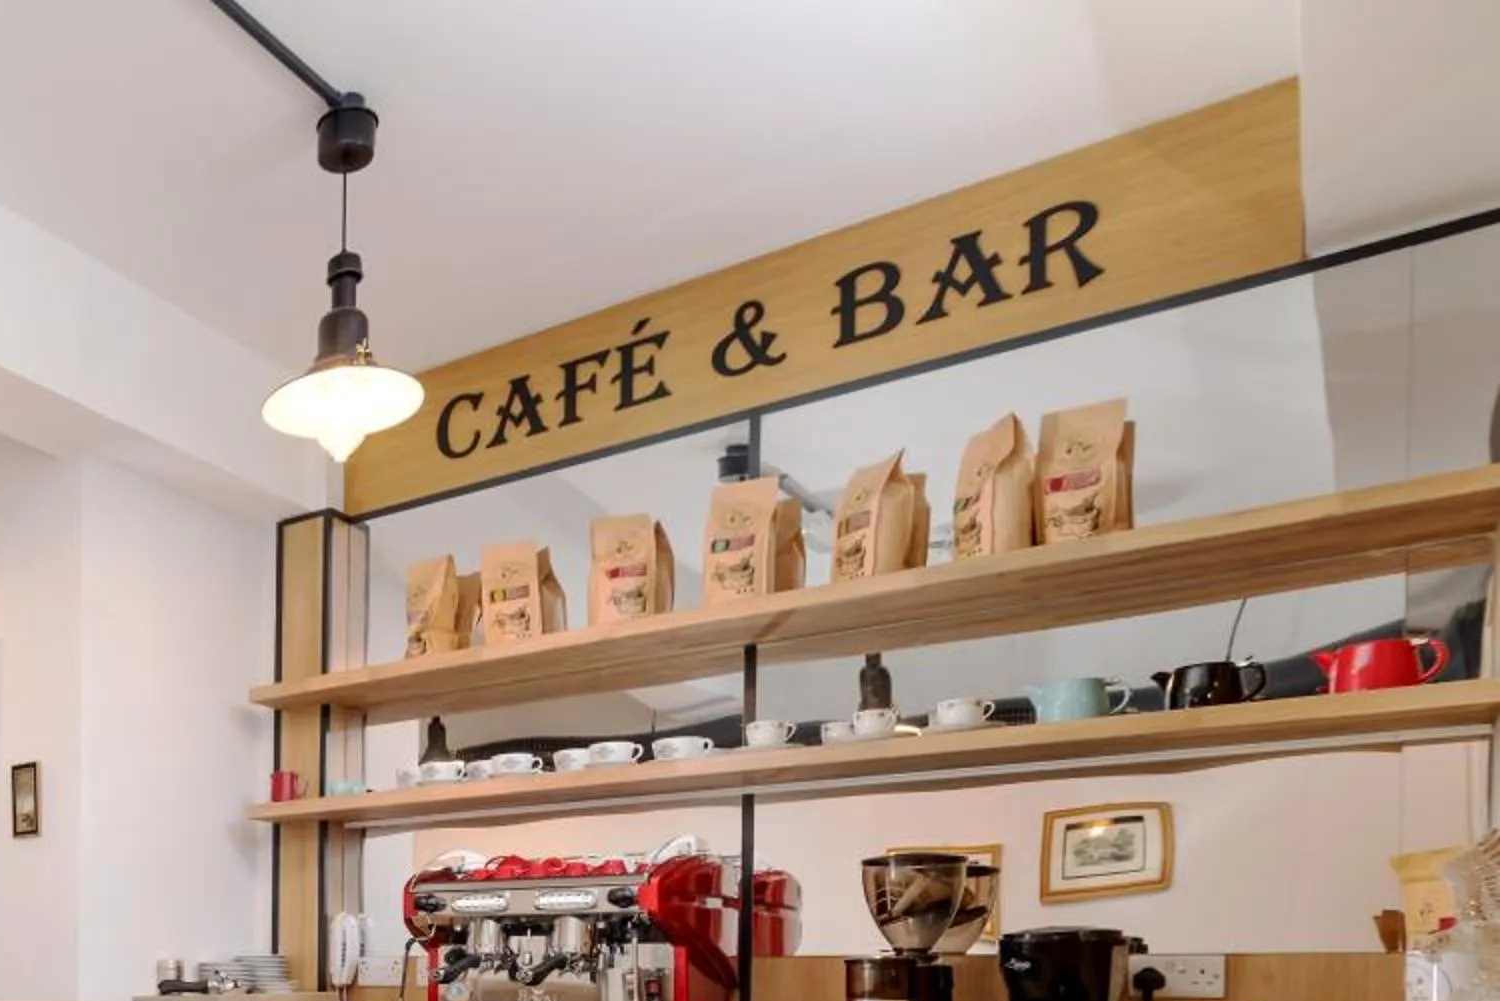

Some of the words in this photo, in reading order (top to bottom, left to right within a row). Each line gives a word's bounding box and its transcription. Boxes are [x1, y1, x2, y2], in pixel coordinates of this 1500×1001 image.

[436, 317, 672, 460] CAFÉ
[711, 299, 786, 377] &
[831, 200, 1106, 349] BAR
